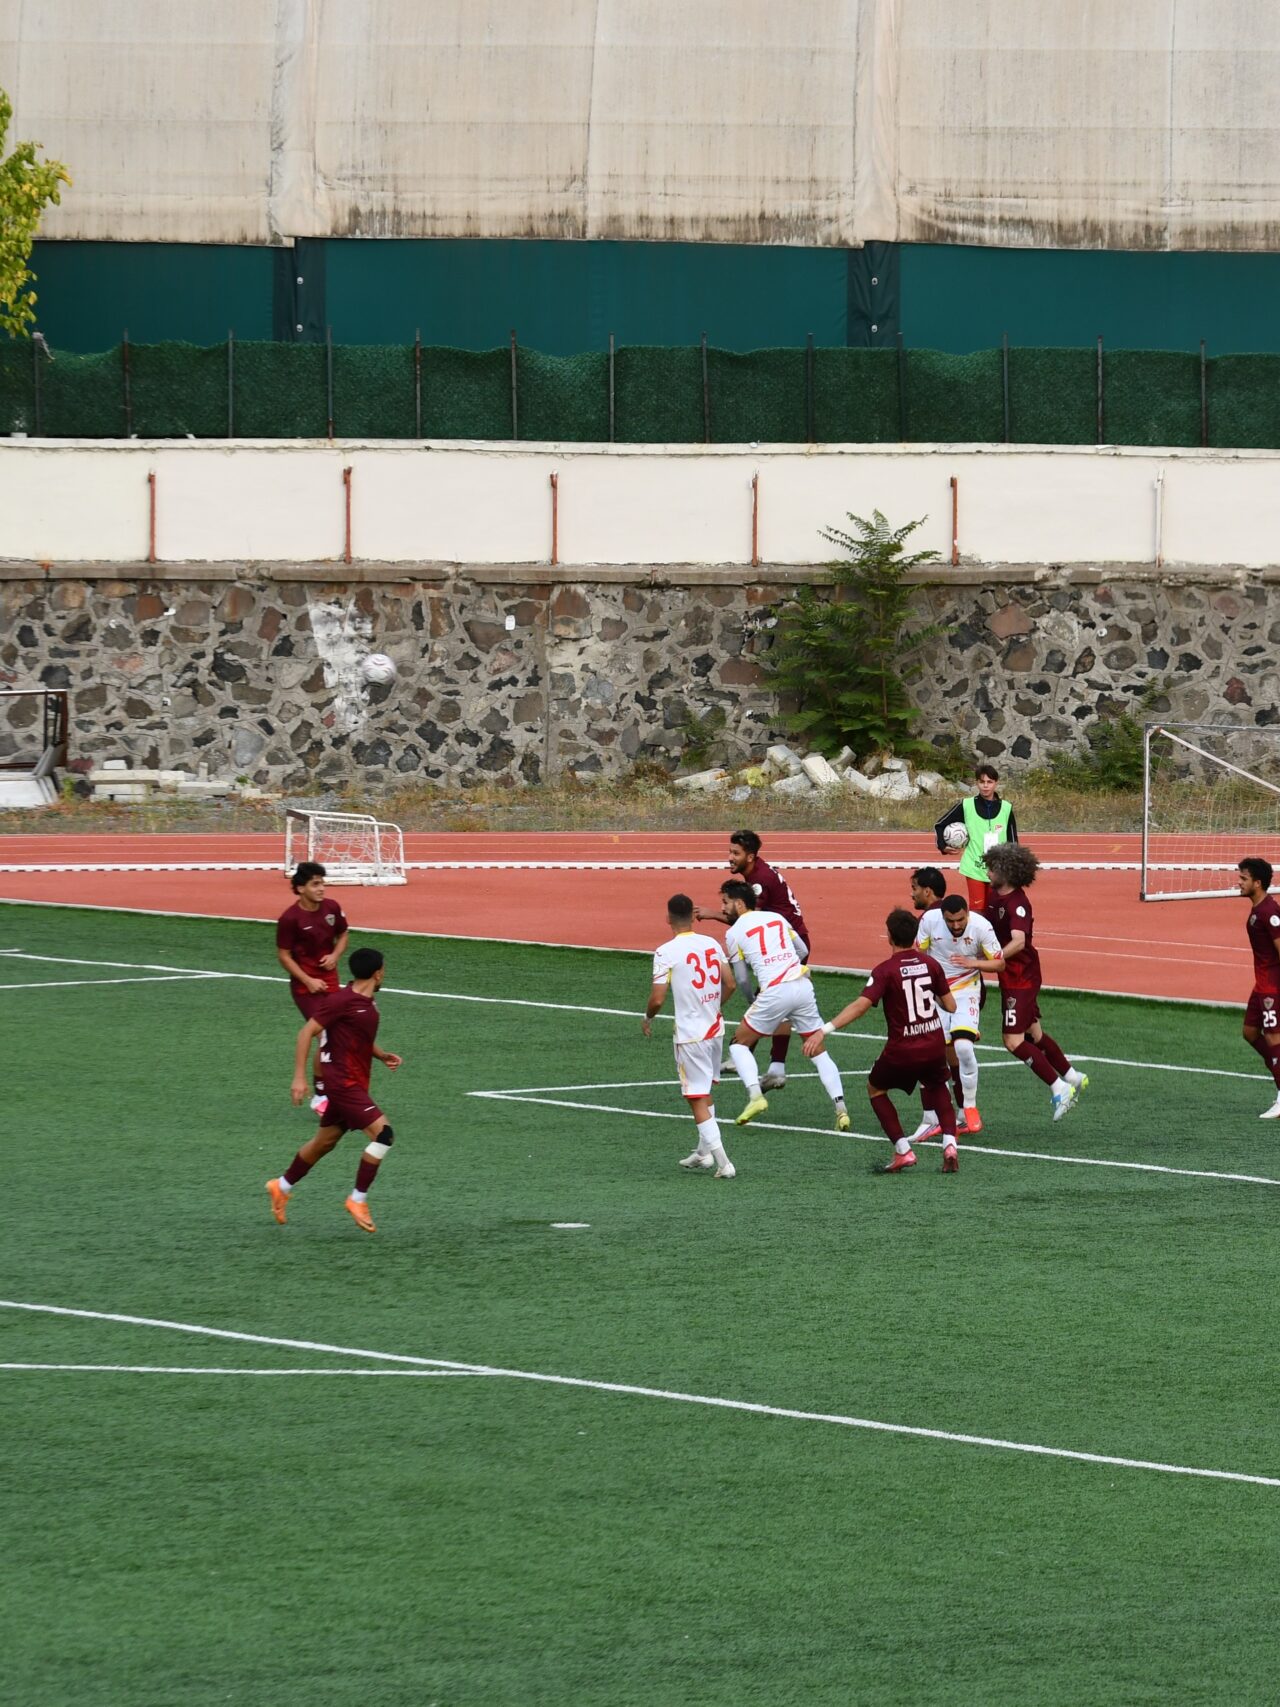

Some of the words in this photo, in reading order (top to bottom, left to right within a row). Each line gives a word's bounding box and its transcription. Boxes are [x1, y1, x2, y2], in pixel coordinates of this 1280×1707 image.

[746, 920, 786, 955] 77
[686, 947, 721, 989] 35
[902, 976, 933, 1023] 16
[1005, 1009, 1016, 1026] 15
[1263, 1010, 1277, 1028] 25
